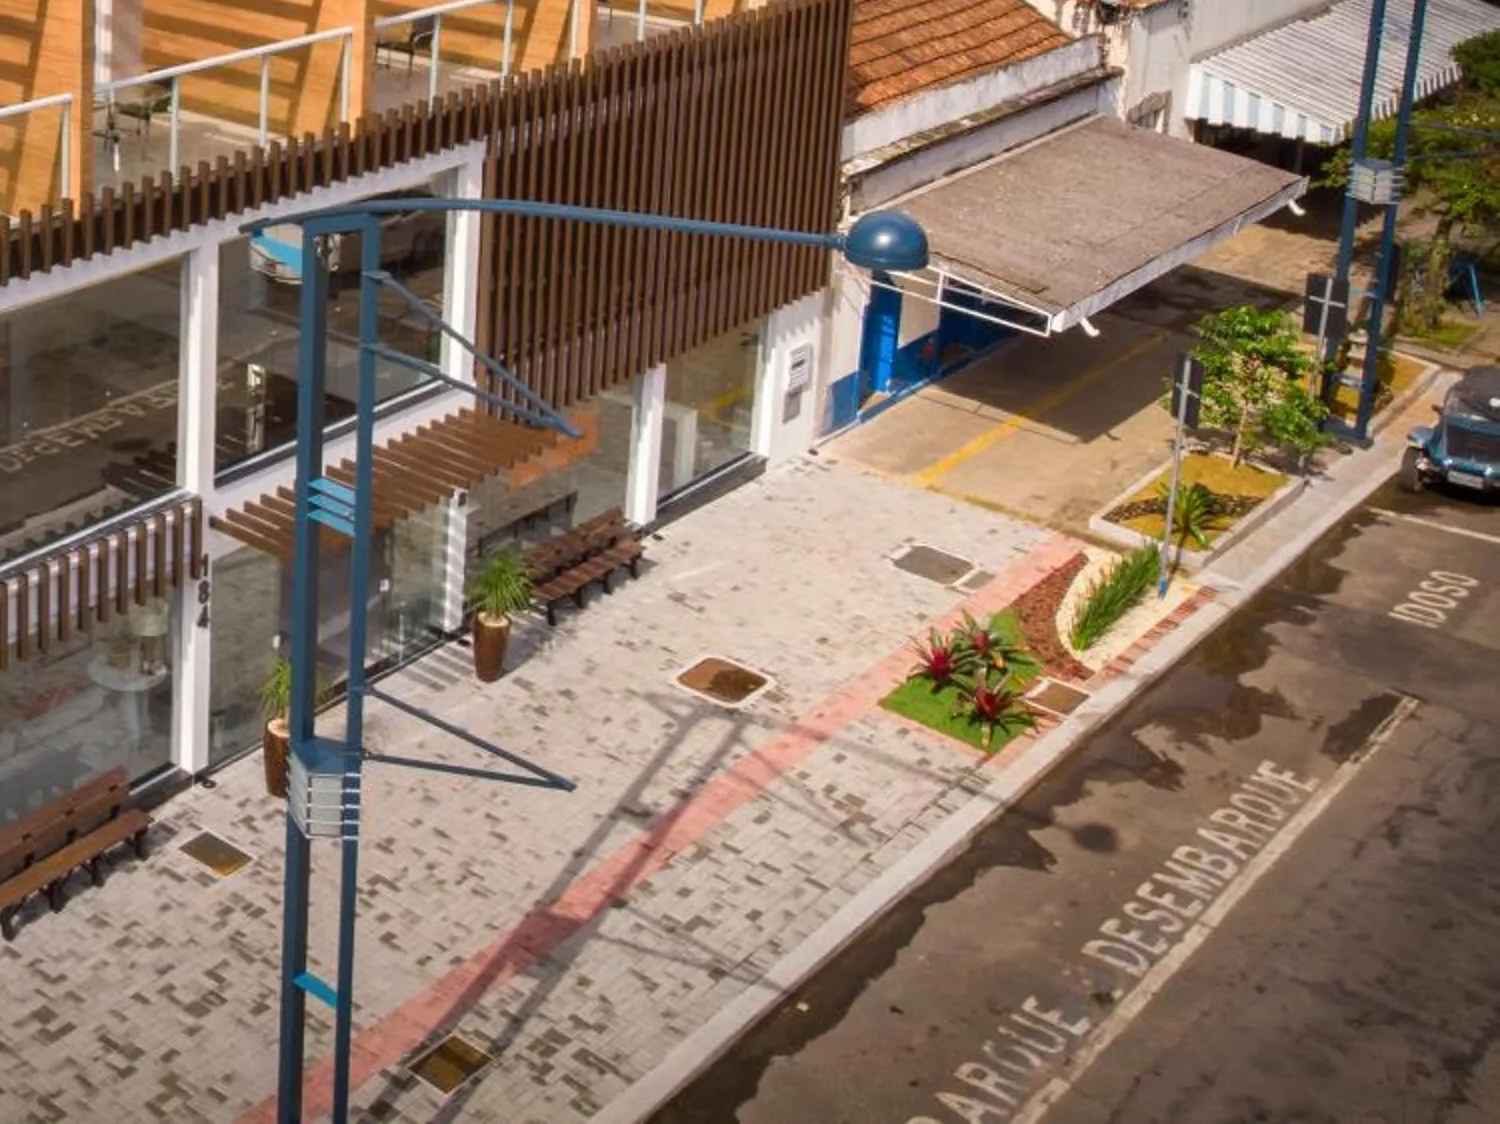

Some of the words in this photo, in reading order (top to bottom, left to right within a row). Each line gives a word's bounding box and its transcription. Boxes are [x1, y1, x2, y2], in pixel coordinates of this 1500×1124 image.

[1388, 571, 1480, 629] IDOSO
[904, 994, 1091, 1124] ARQUE
[1080, 759, 1320, 978] DESEMBARQUE
